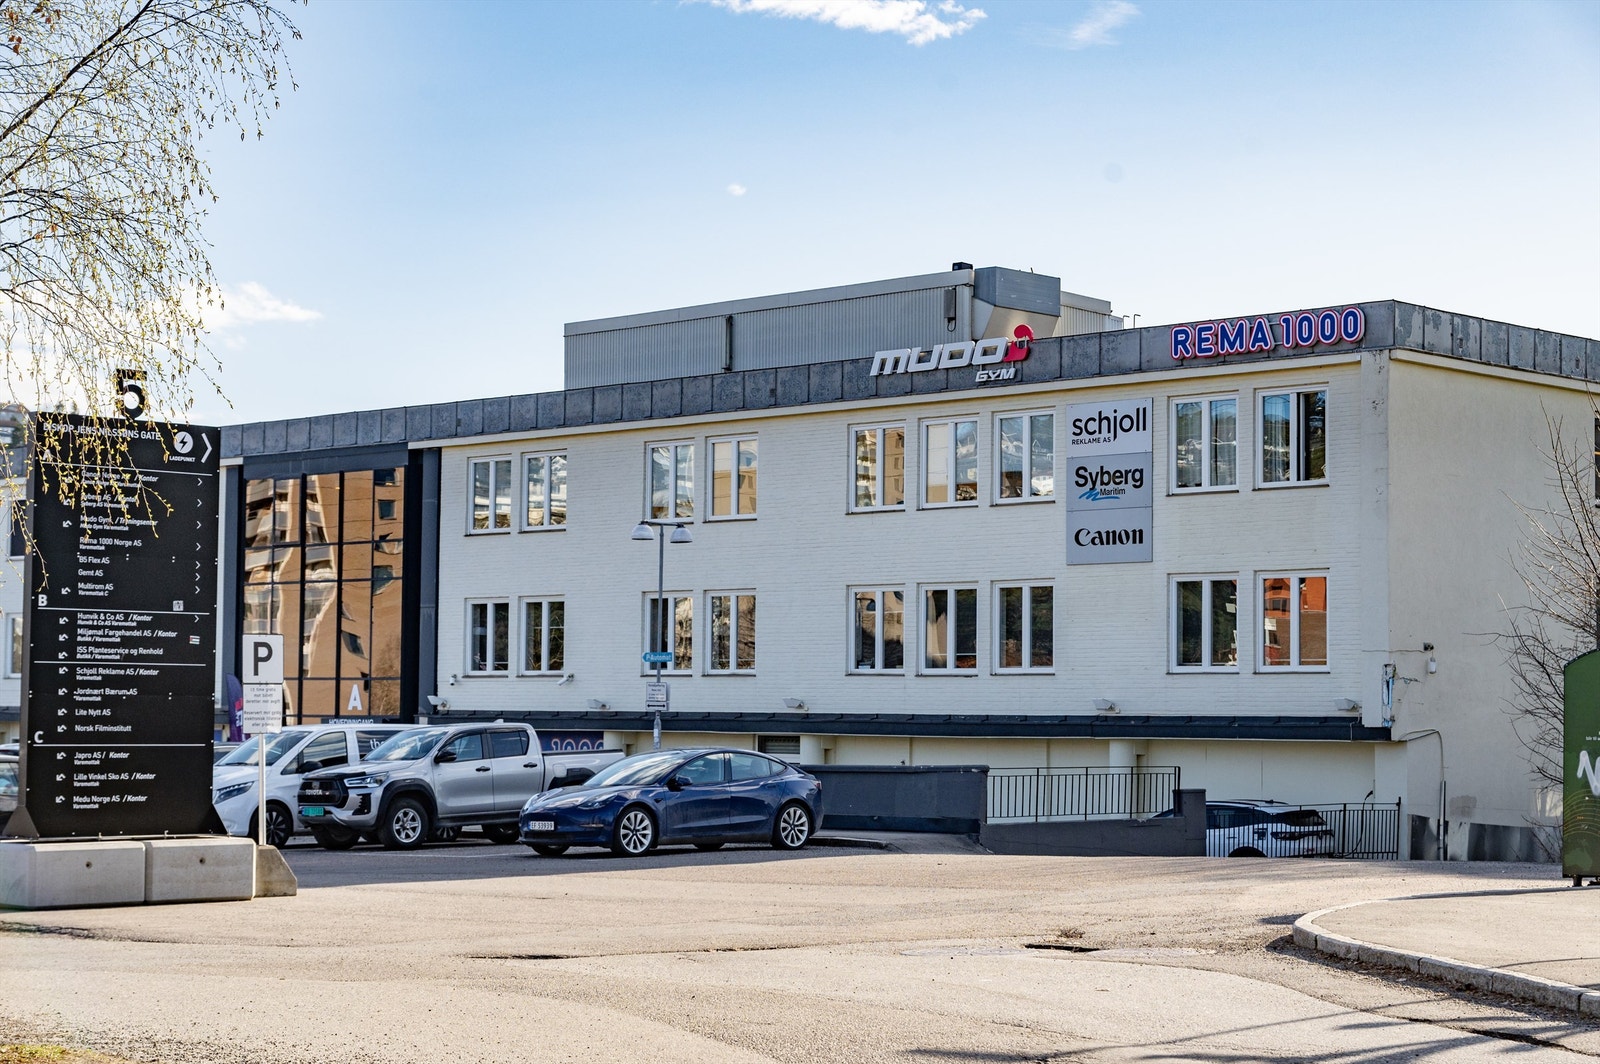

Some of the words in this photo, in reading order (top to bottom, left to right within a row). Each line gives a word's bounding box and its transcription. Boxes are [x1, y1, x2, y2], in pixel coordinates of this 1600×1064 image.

[1171, 316, 1273, 360] REMA
[1280, 306, 1364, 348] 1000
[870, 336, 1008, 376] MUDO
[976, 367, 1016, 382] GYM
[116, 369, 148, 420] 5
[1072, 406, 1146, 441] schjoll
[76, 425, 96, 435] JENS
[140, 431, 161, 440] GATE
[1075, 465, 1144, 491] Syberg
[1100, 487, 1125, 496] Maritim
[114, 539, 134, 547] Norge
[1074, 528, 1143, 546] Canon
[38, 594, 47, 606] B
[104, 629, 142, 637] Fargehandel
[253, 642, 273, 676] P
[76, 667, 97, 676] Schjoll
[348, 684, 362, 710] A
[88, 709, 101, 717] Nytt
[34, 731, 44, 743] C
